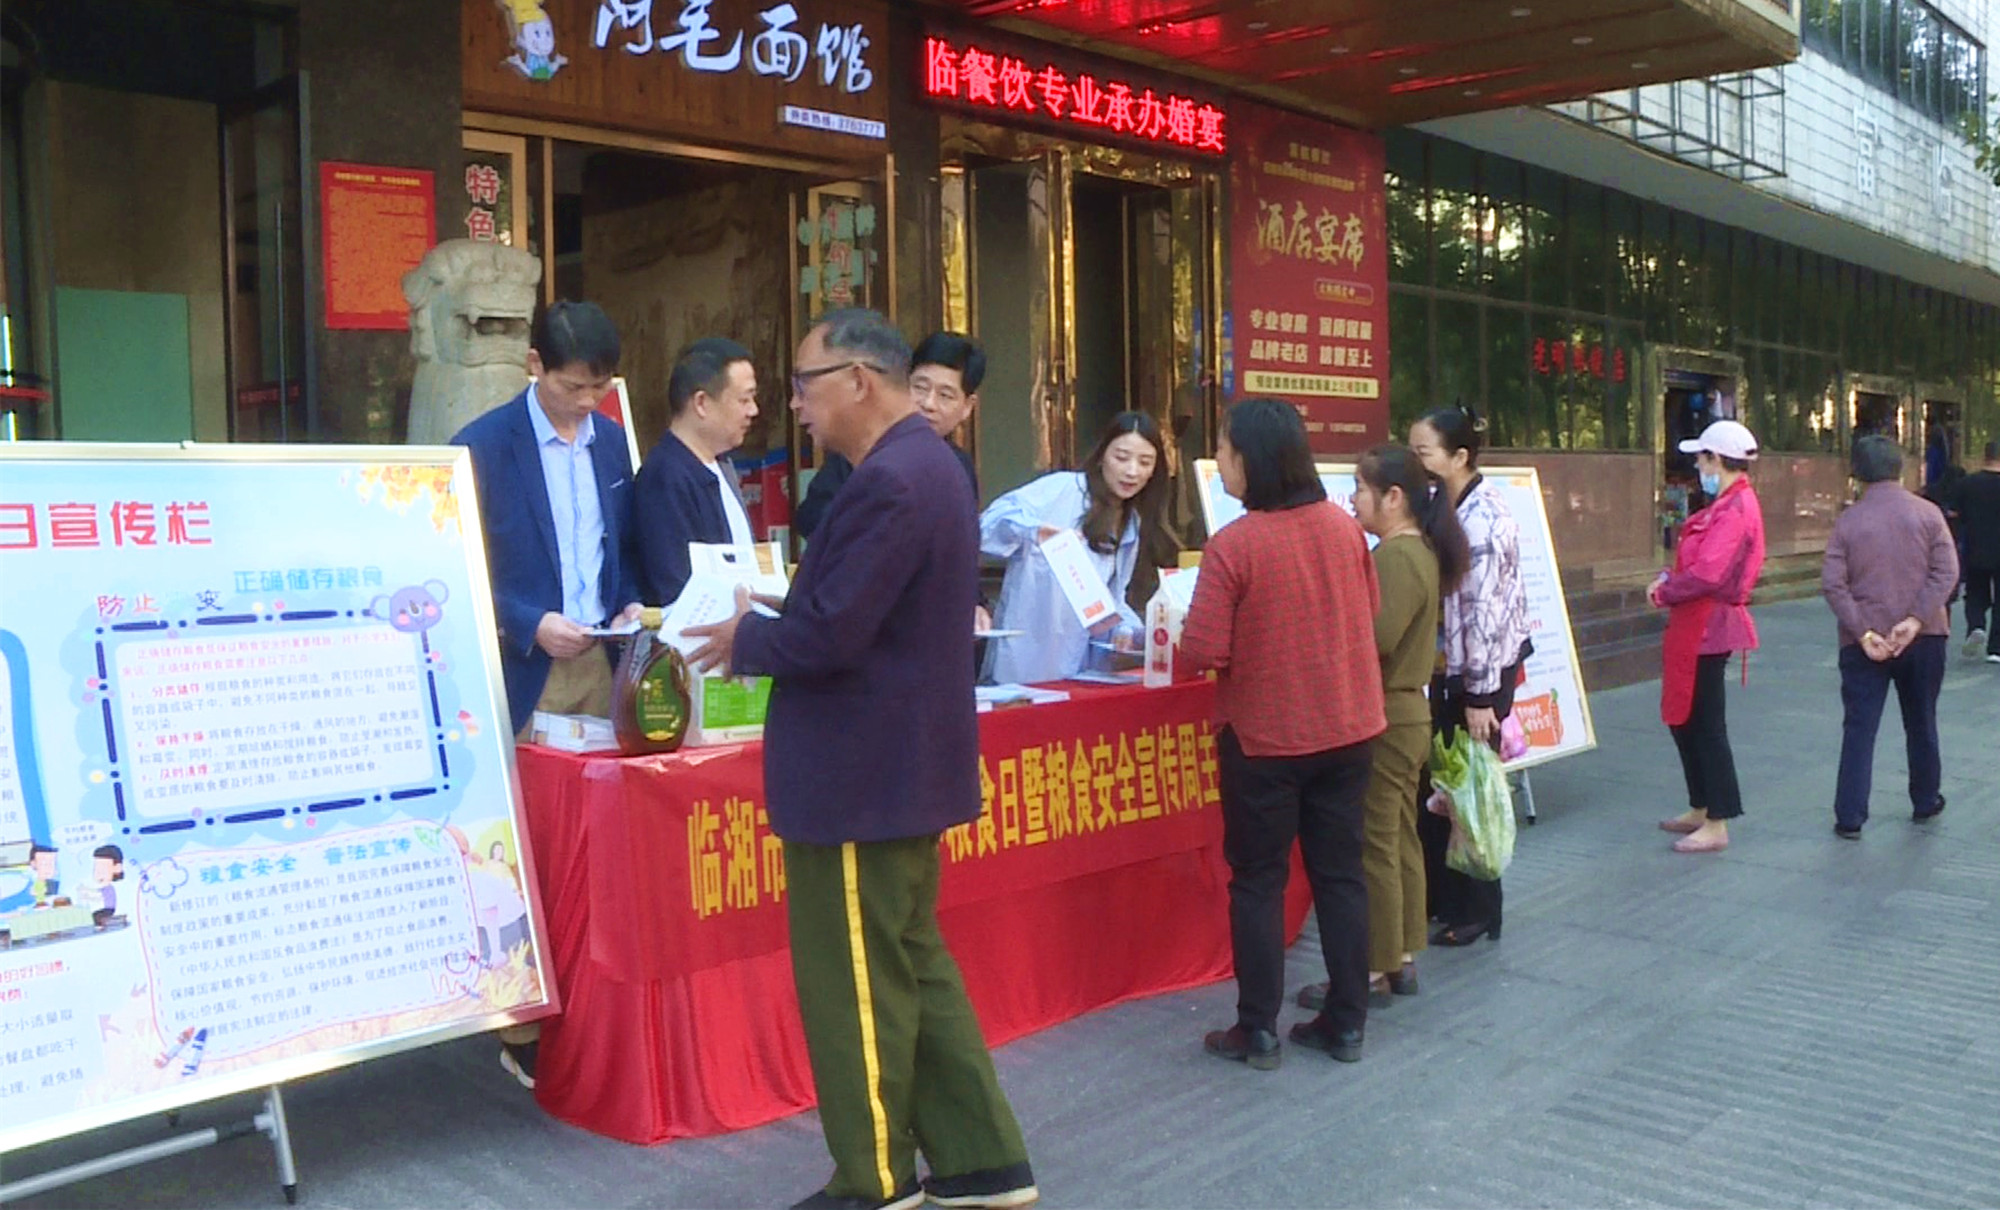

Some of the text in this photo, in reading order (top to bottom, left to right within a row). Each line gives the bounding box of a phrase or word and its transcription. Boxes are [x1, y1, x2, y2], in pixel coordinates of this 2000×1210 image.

[925, 37, 1226, 152] 临餐饮专业承办婚宴
[1256, 199, 1364, 272] 酒店宴席
[0, 501, 212, 548] 日宣传栏
[234, 567, 384, 594] 正确储存粮食
[687, 796, 787, 920] 临湘市
